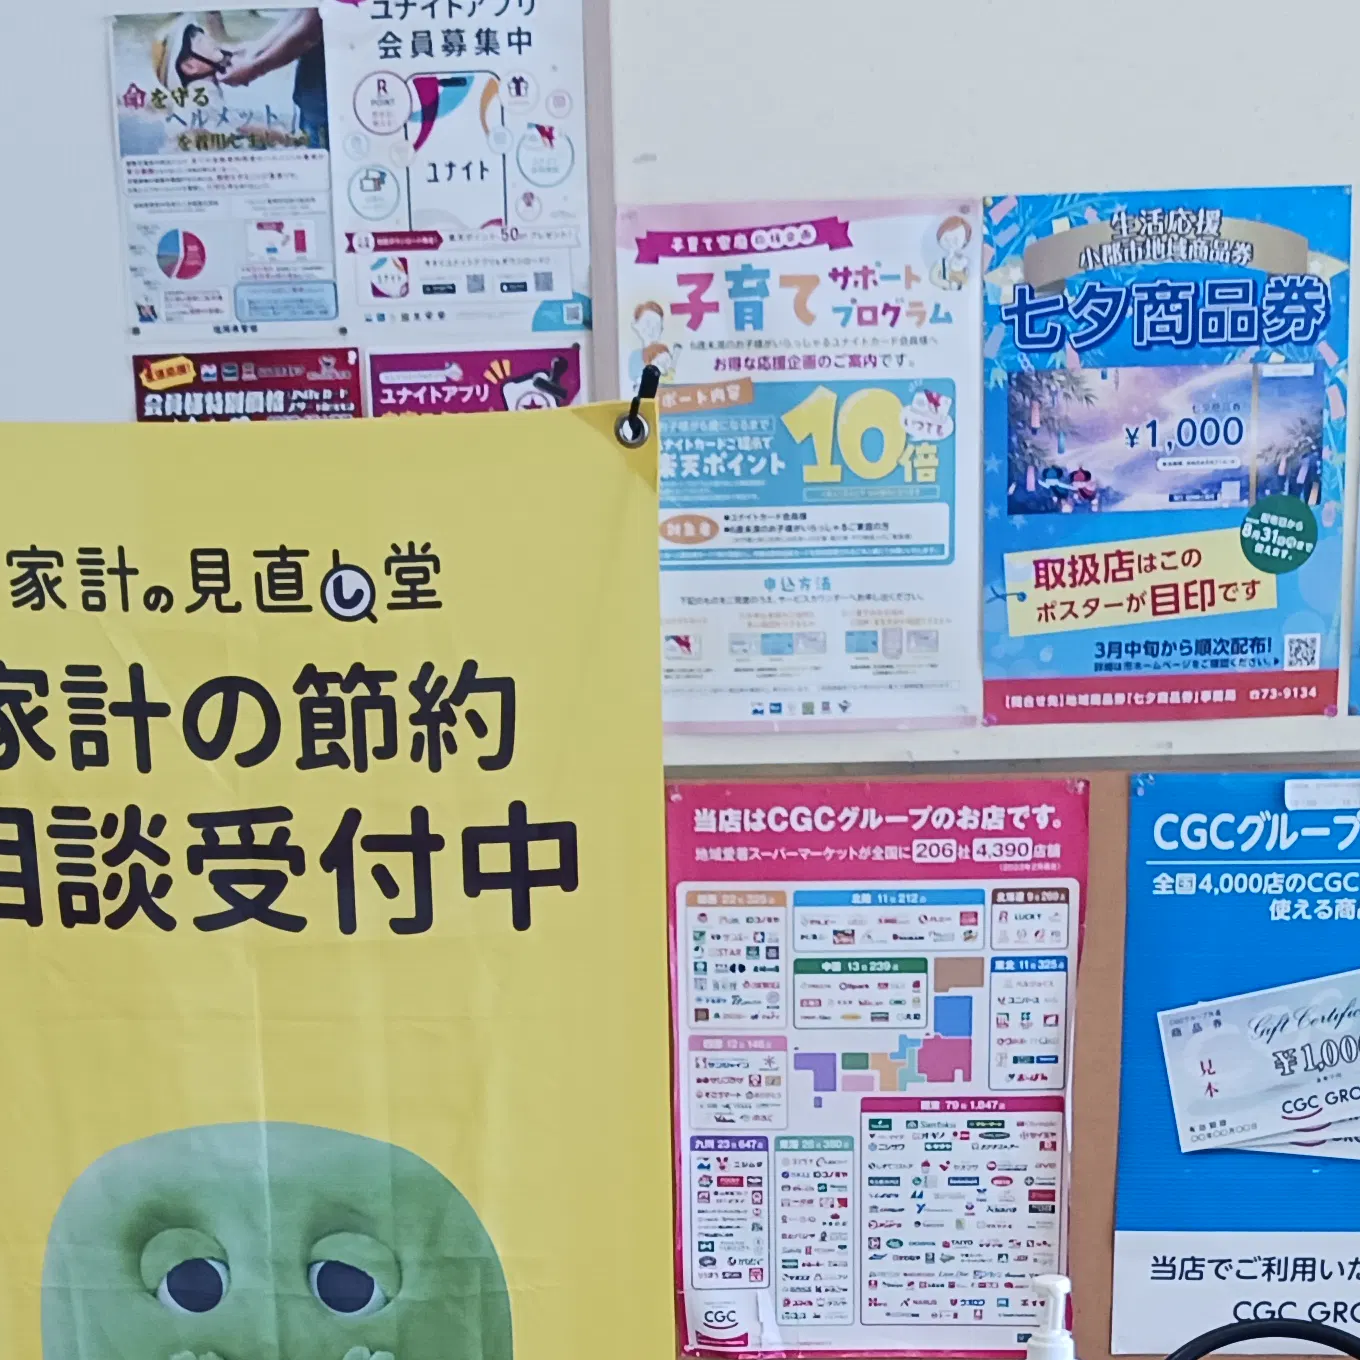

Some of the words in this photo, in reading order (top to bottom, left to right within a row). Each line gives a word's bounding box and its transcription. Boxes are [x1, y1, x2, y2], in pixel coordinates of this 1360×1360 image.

[377, 27, 533, 59] 会員募集中
[166, 104, 279, 128] ヘルメット
[427, 161, 490, 183] ユナイト
[1111, 207, 1223, 239] 生活応援
[828, 260, 921, 291] サポート
[670, 263, 821, 332] 子育て
[832, 297, 953, 328] プログラム
[1001, 275, 1331, 351] 七夕商品券
[380, 384, 490, 405] ユナイトアプリ
[661, 384, 741, 408] ポート内容
[1125, 416, 1244, 452] ¥1,000
[660, 452, 786, 479] 楽天ポイント
[6, 540, 443, 623] 家計の見直し堂
[1032, 546, 1202, 592] 取扱店はこの
[1036, 577, 1262, 625] ポスターが目印です
[1094, 637, 1273, 661] 3月中旬から順次配布!
[693, 803, 1062, 834] 当店はCGCグループのお店です。
[1247, 1014, 1291, 1045] Gift
[1281, 1094, 1319, 1116] CGC
[704, 1309, 737, 1325] CGC
[1233, 1301, 1297, 1323] CGC
